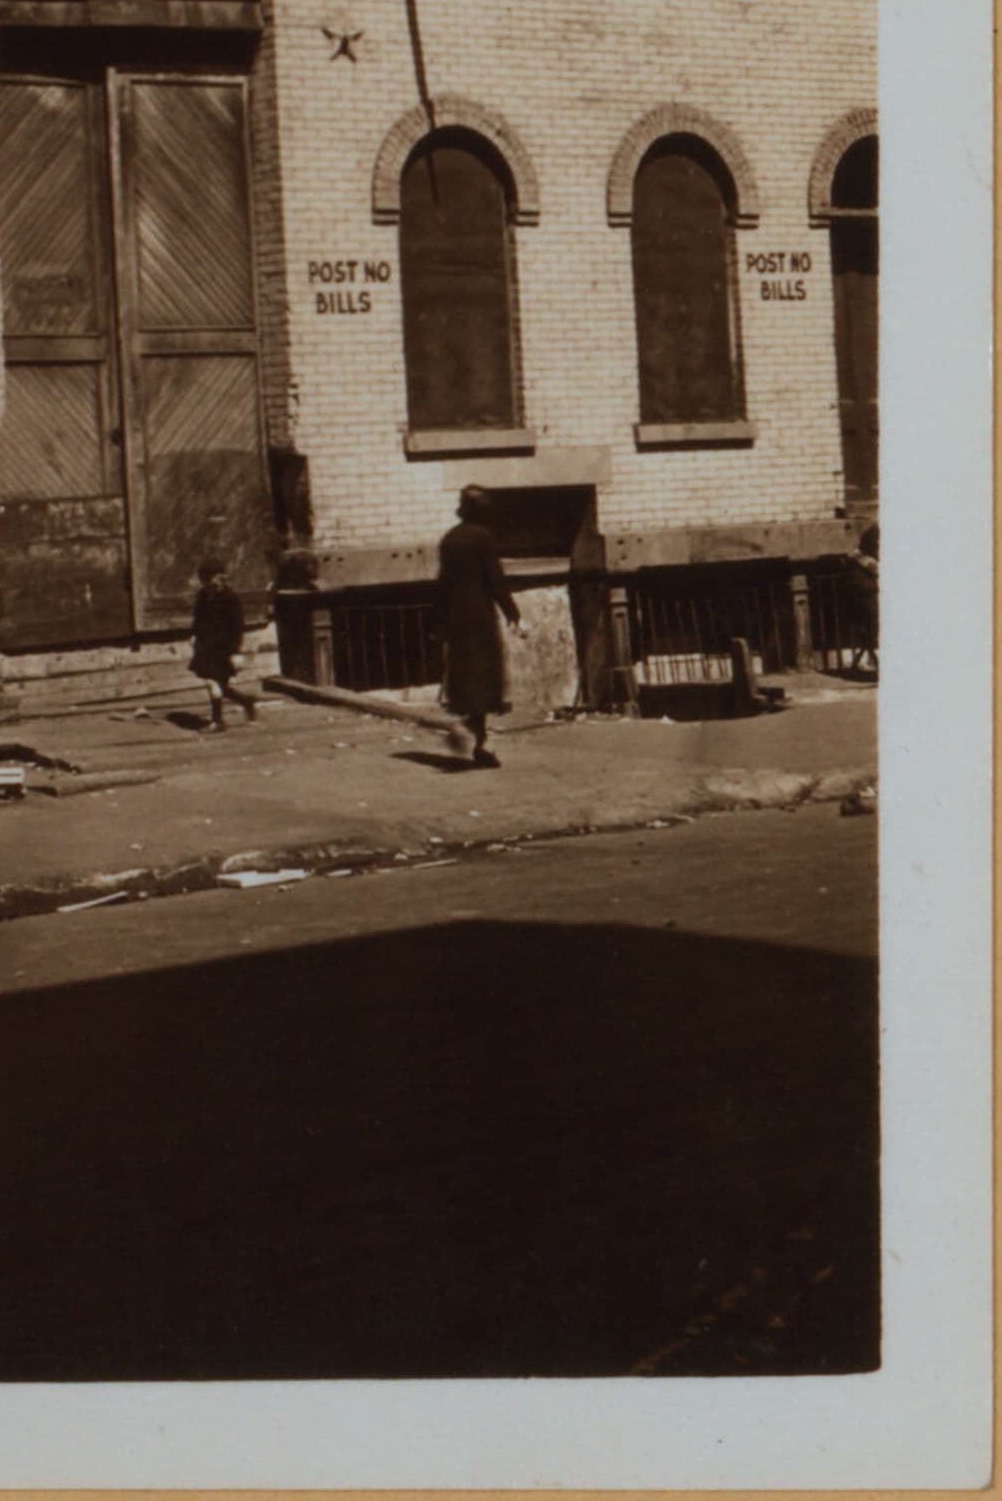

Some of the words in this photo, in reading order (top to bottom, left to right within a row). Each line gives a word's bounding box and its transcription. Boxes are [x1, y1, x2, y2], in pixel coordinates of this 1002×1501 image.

[308, 260, 357, 283] POST
[364, 260, 391, 282] NO
[745, 252, 785, 273] POST
[789, 252, 812, 273] NO
[760, 280, 806, 301] BILLS
[316, 291, 372, 314] BILLS
